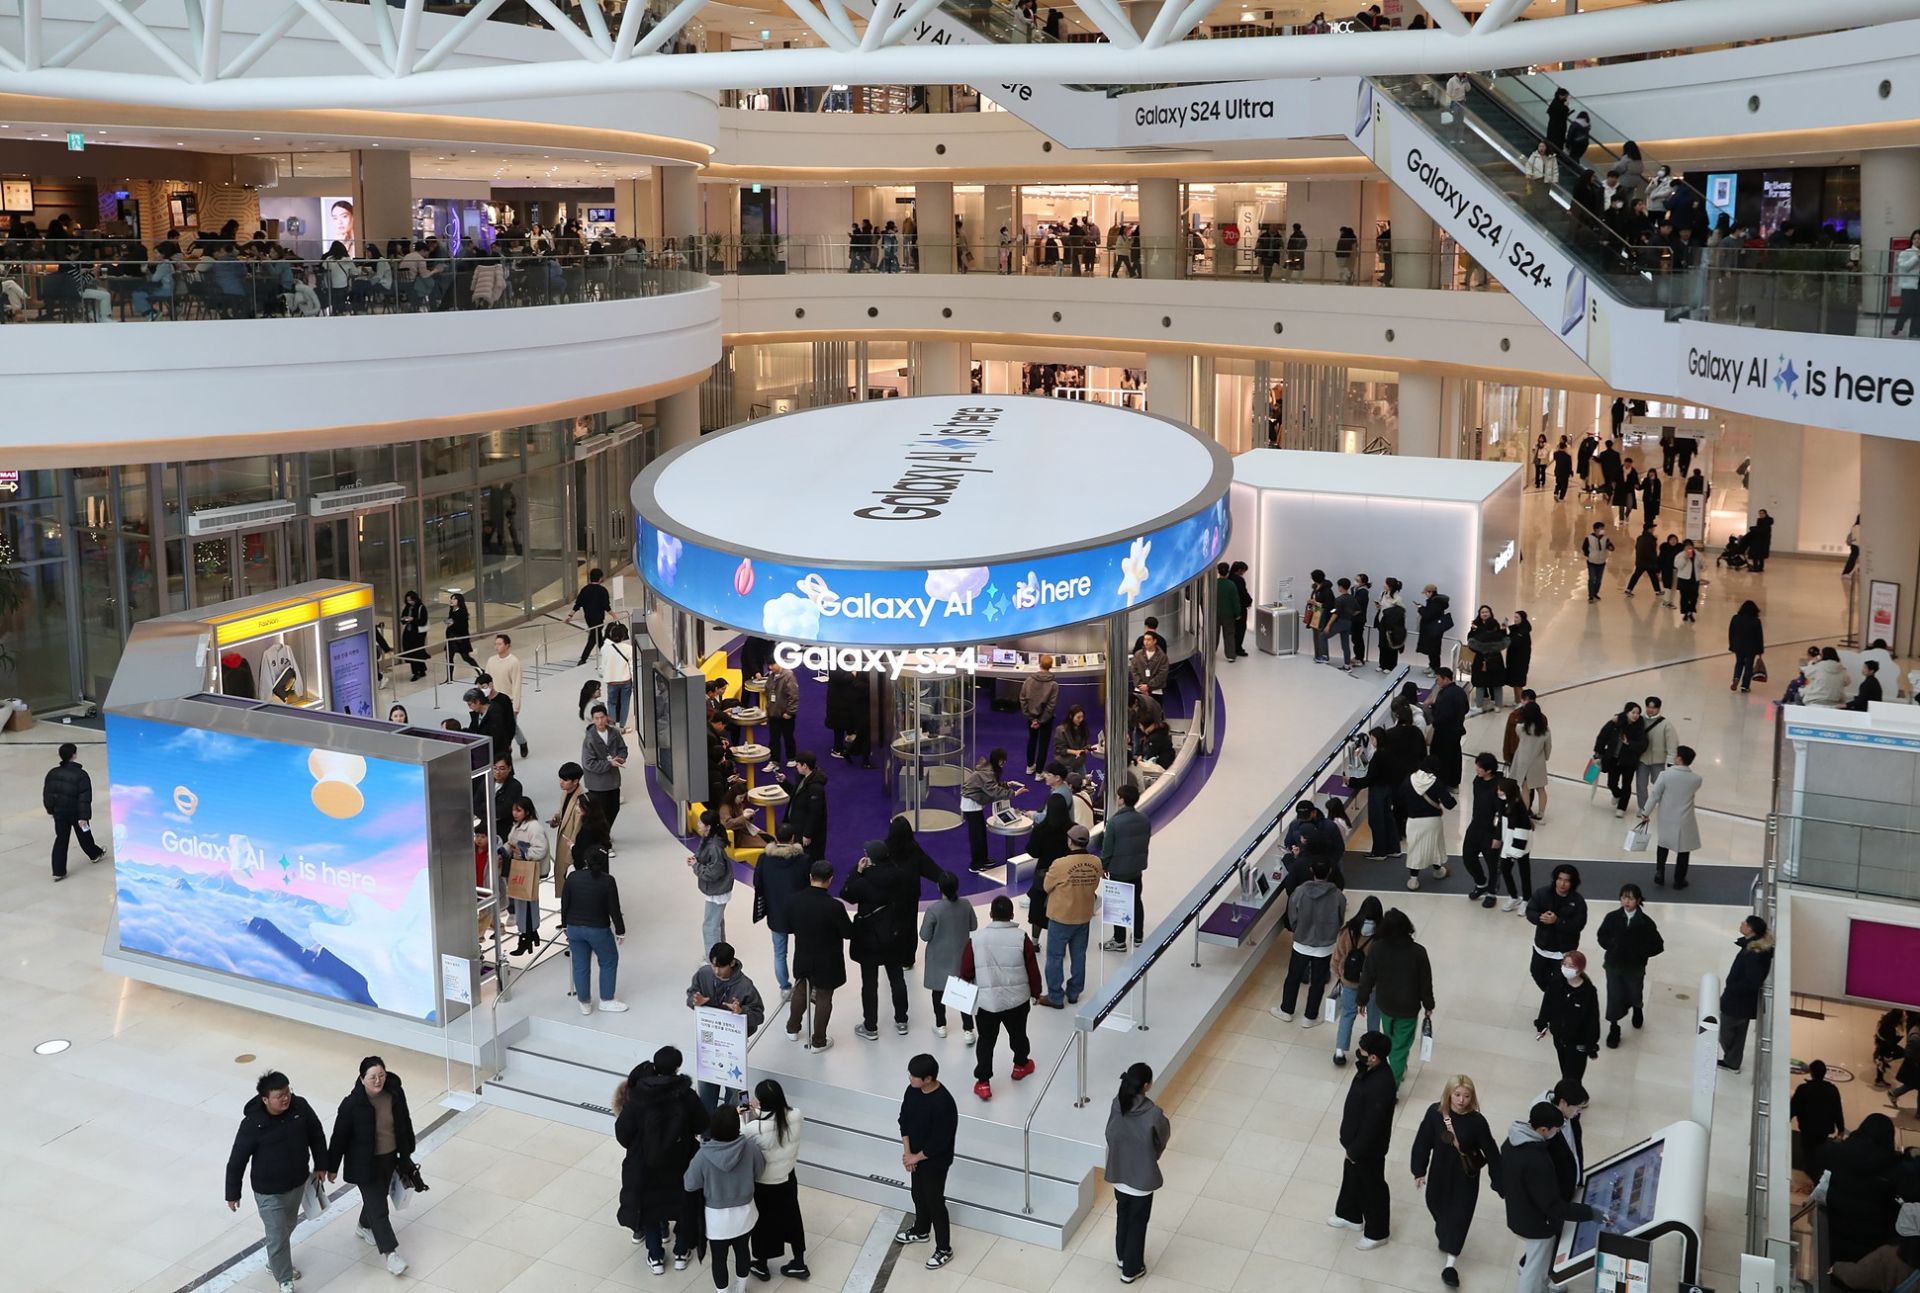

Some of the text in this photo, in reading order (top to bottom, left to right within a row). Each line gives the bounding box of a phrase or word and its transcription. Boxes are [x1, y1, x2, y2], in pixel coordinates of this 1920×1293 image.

[1135, 98, 1274, 128] Galaxy S24 Ultra
[1243, 211, 1253, 261] SALE
[1407, 148, 1552, 288] Galaxy S24 S24+
[1688, 347, 1915, 407] Galaxy AI is here
[853, 407, 1005, 520] Galaxy AI is here
[818, 575, 1092, 627] Galaxy AI is here
[773, 641, 978, 681] Galaxy S24
[245, 846, 265, 871] AI
[298, 855, 317, 881] is
[321, 861, 377, 891] here
